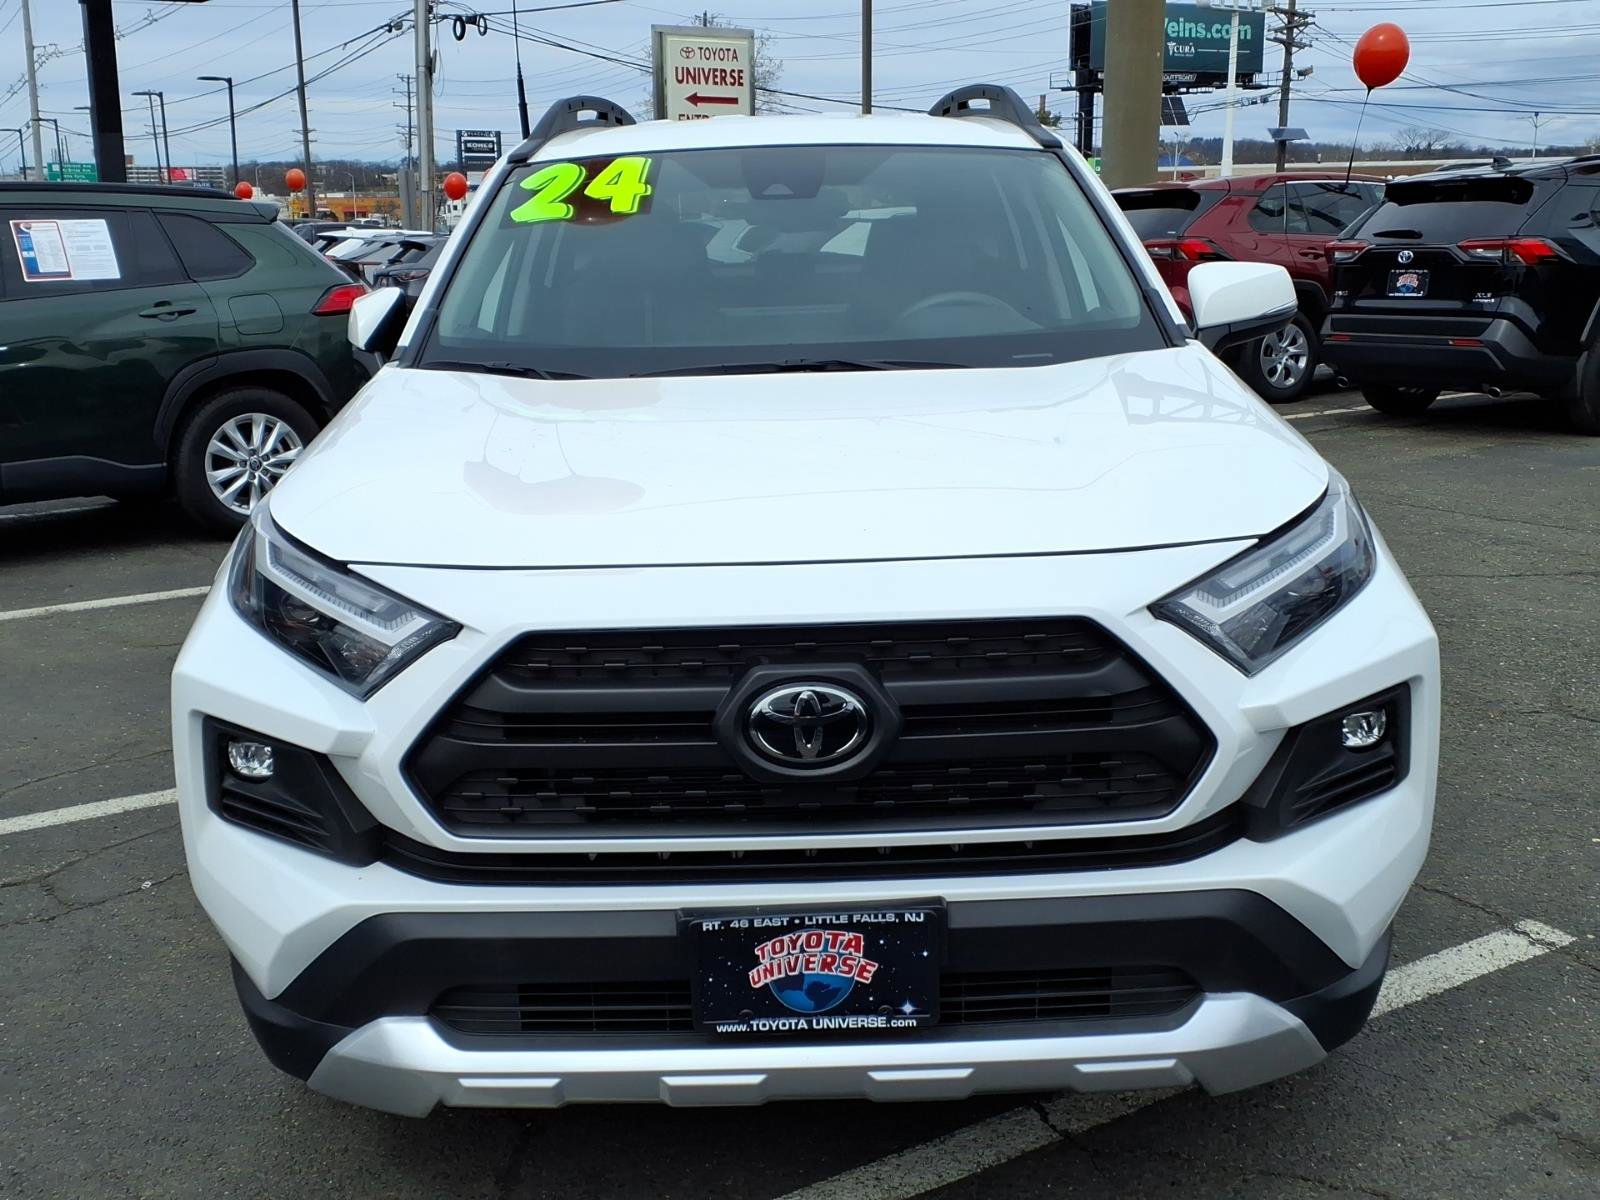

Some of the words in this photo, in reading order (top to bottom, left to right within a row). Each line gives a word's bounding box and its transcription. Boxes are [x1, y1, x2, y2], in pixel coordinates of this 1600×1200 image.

[1164, 17, 1252, 39] eins.com
[698, 47, 739, 62] TOYOTA
[674, 66, 745, 87] UNIVERSE
[510, 156, 652, 223] 24
[702, 921, 725, 932] RT.
[730, 919, 749, 929] 46
[754, 917, 790, 928] EAST
[804, 915, 849, 925] LITTLE
[853, 913, 899, 924] FALLS,
[904, 912, 925, 922] NJ
[755, 930, 865, 963] TOYOTA
[748, 952, 879, 989] UNIVERSE
[716, 1019, 808, 1033] www.TOYOTA
[812, 1016, 917, 1030] UNIVERSE.com
